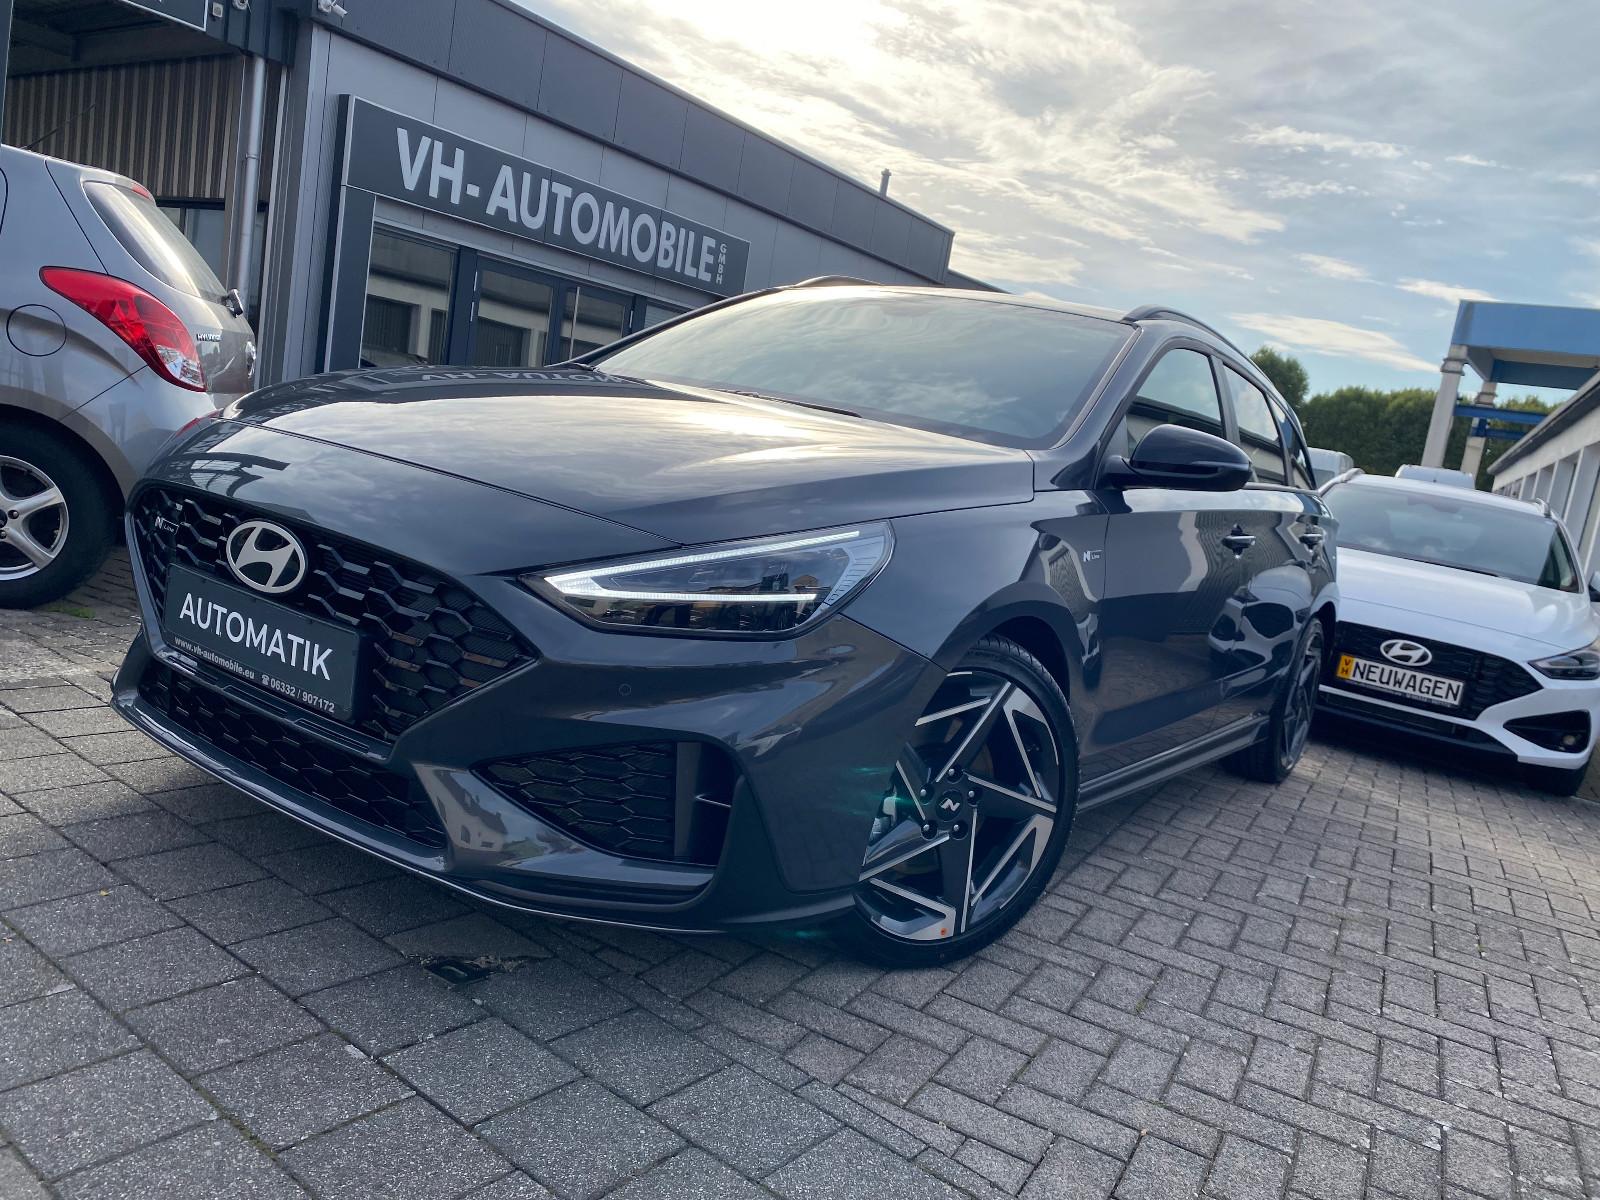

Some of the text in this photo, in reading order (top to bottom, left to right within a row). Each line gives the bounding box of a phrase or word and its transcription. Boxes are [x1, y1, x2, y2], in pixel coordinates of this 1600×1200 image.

[174, 636, 255, 680] www.vh-automobile.eu
[270, 678, 296, 697] 06332
[302, 691, 335, 713] 907172
[179, 592, 333, 681] AUTOMATIK
[1352, 661, 1460, 702] NEUWAGEN
